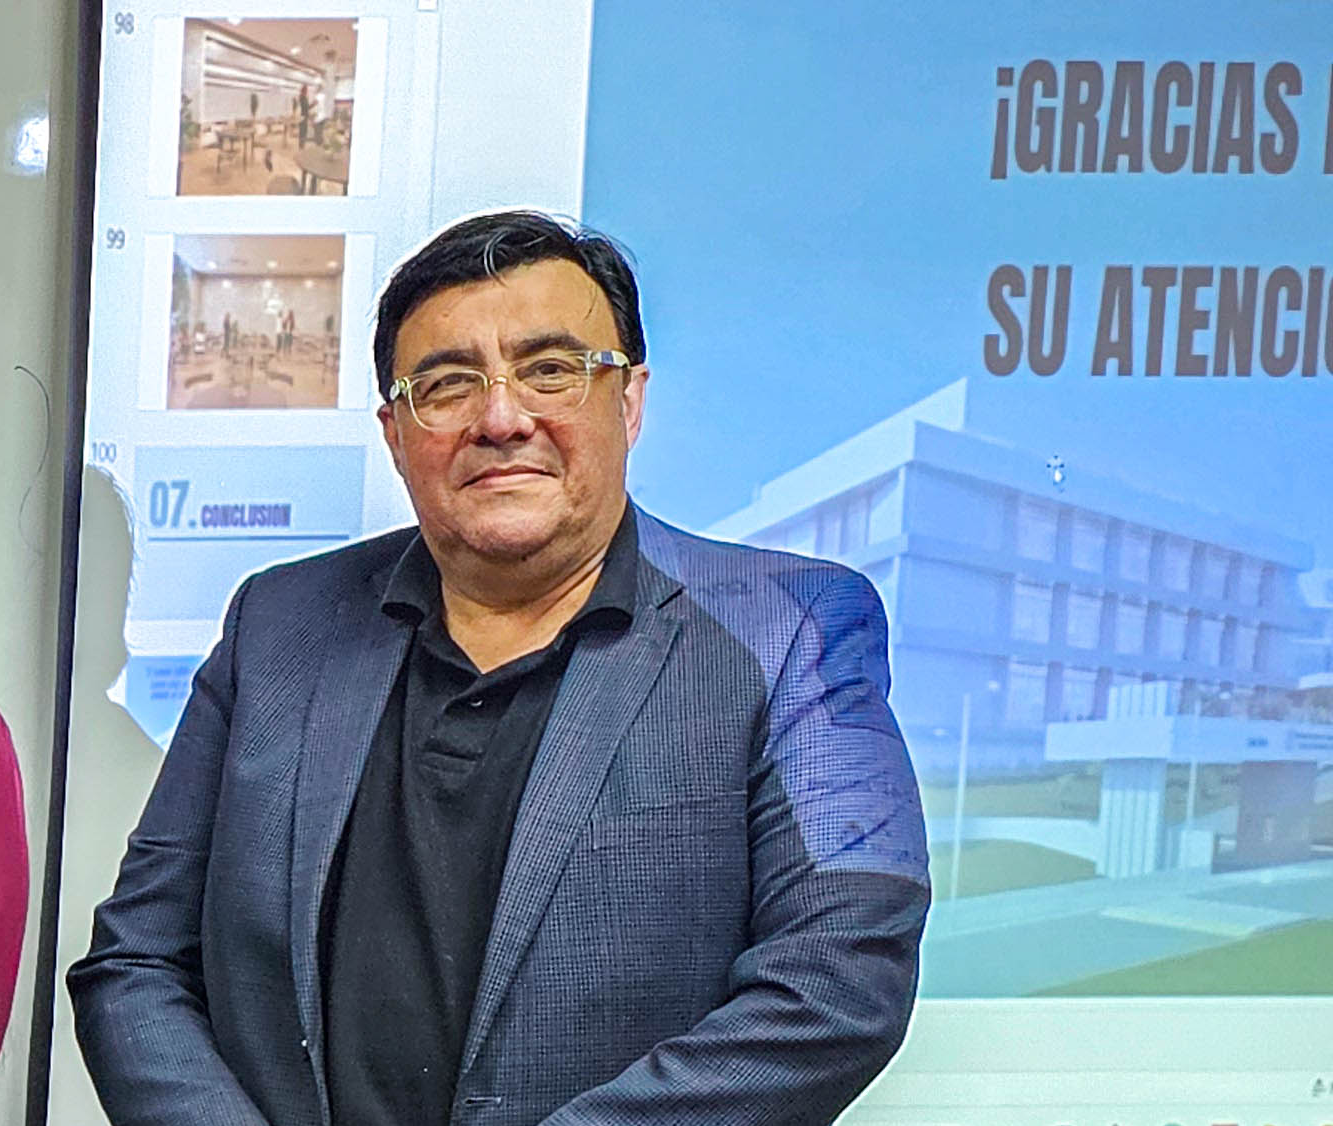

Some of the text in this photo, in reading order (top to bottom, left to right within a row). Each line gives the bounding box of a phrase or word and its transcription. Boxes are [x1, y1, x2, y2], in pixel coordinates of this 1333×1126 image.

[114, 12, 134, 35] 98
[990, 59, 1303, 180] ¡GRACIAS
[106, 227, 126, 250] 99
[983, 264, 1333, 378] SU ATENCI
[91, 442, 117, 464] 100
